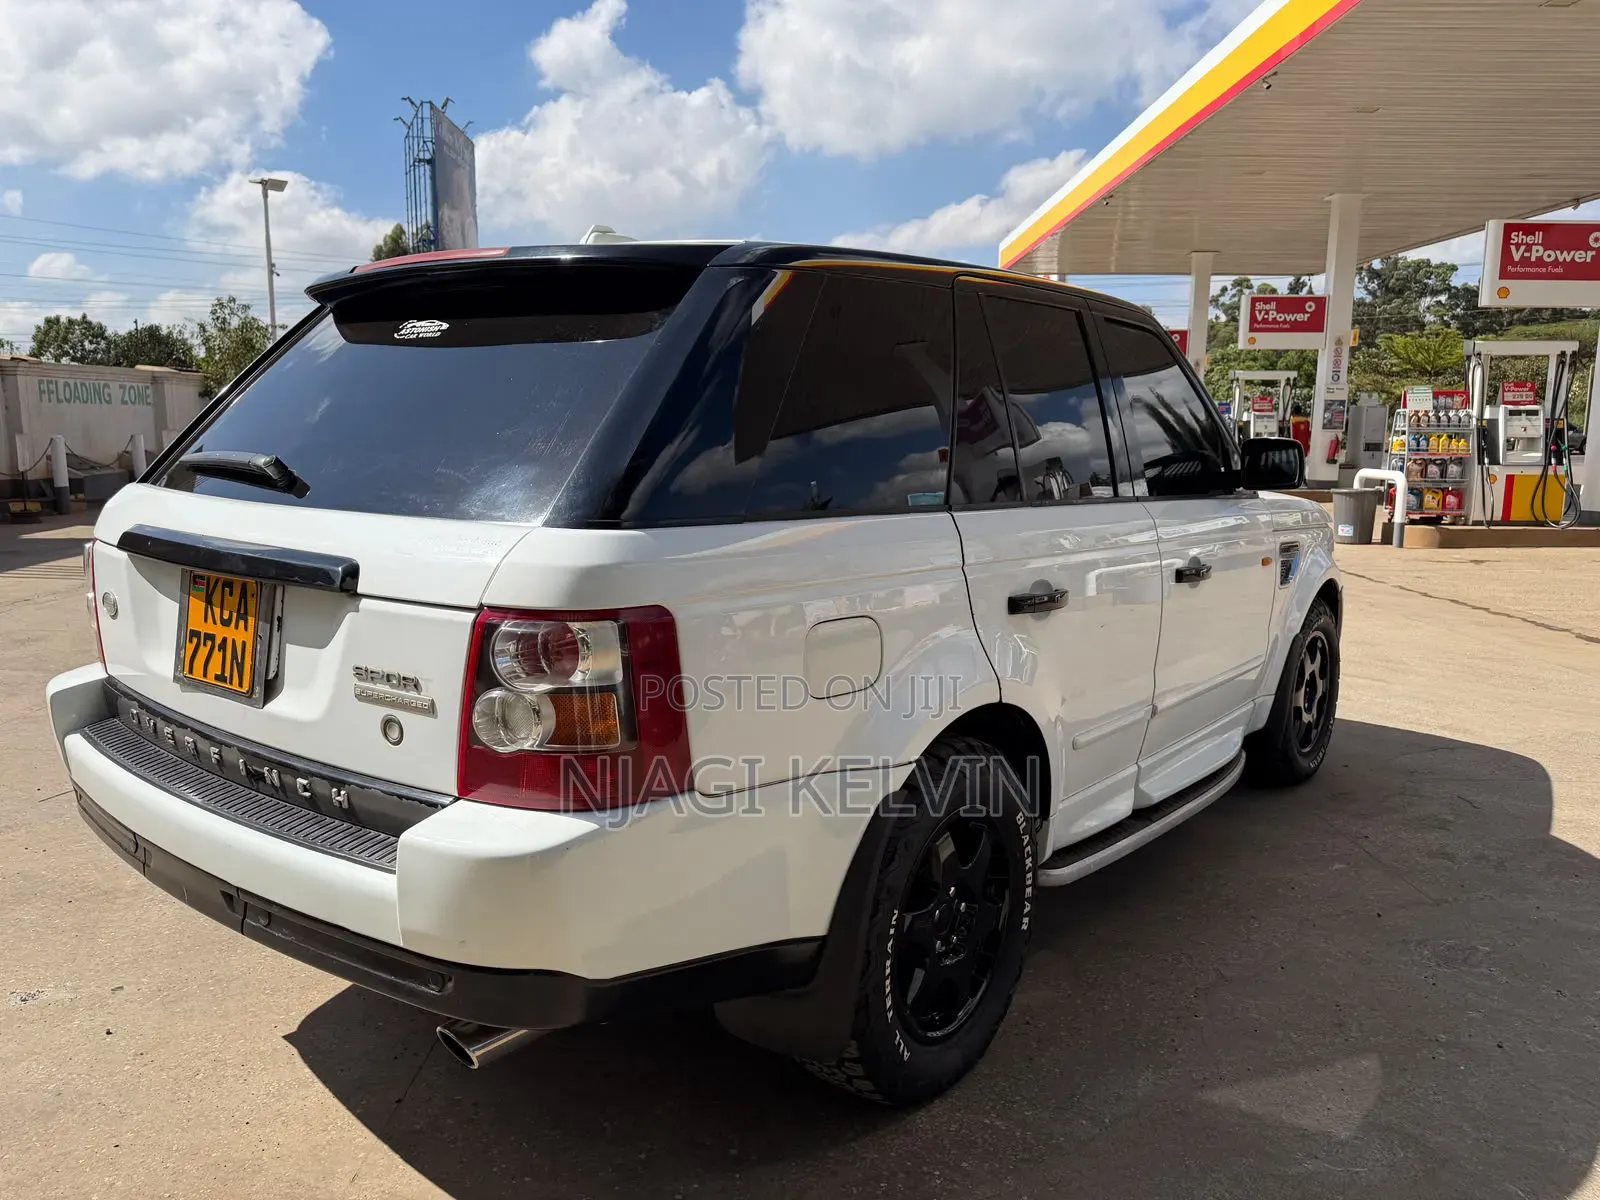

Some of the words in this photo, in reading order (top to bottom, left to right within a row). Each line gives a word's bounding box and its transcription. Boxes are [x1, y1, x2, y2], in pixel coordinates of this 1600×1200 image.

[1510, 231, 1543, 244] Shell
[1510, 245, 1596, 263] V-Power
[1507, 264, 1547, 273] Performance
[1547, 265, 1564, 273] Fuels
[1255, 301, 1276, 311] Shell
[1255, 311, 1311, 322] V-Power
[38, 379, 113, 405] FFLOADING
[119, 384, 152, 406] ZONE
[203, 575, 249, 632] KCA
[188, 628, 247, 689] 771N
[354, 687, 430, 710] SUPERCHARGED
[1015, 811, 1033, 932] BLACKBEAR
[884, 908, 899, 1023] TERRAIN
[894, 1029, 911, 1062] ALL
